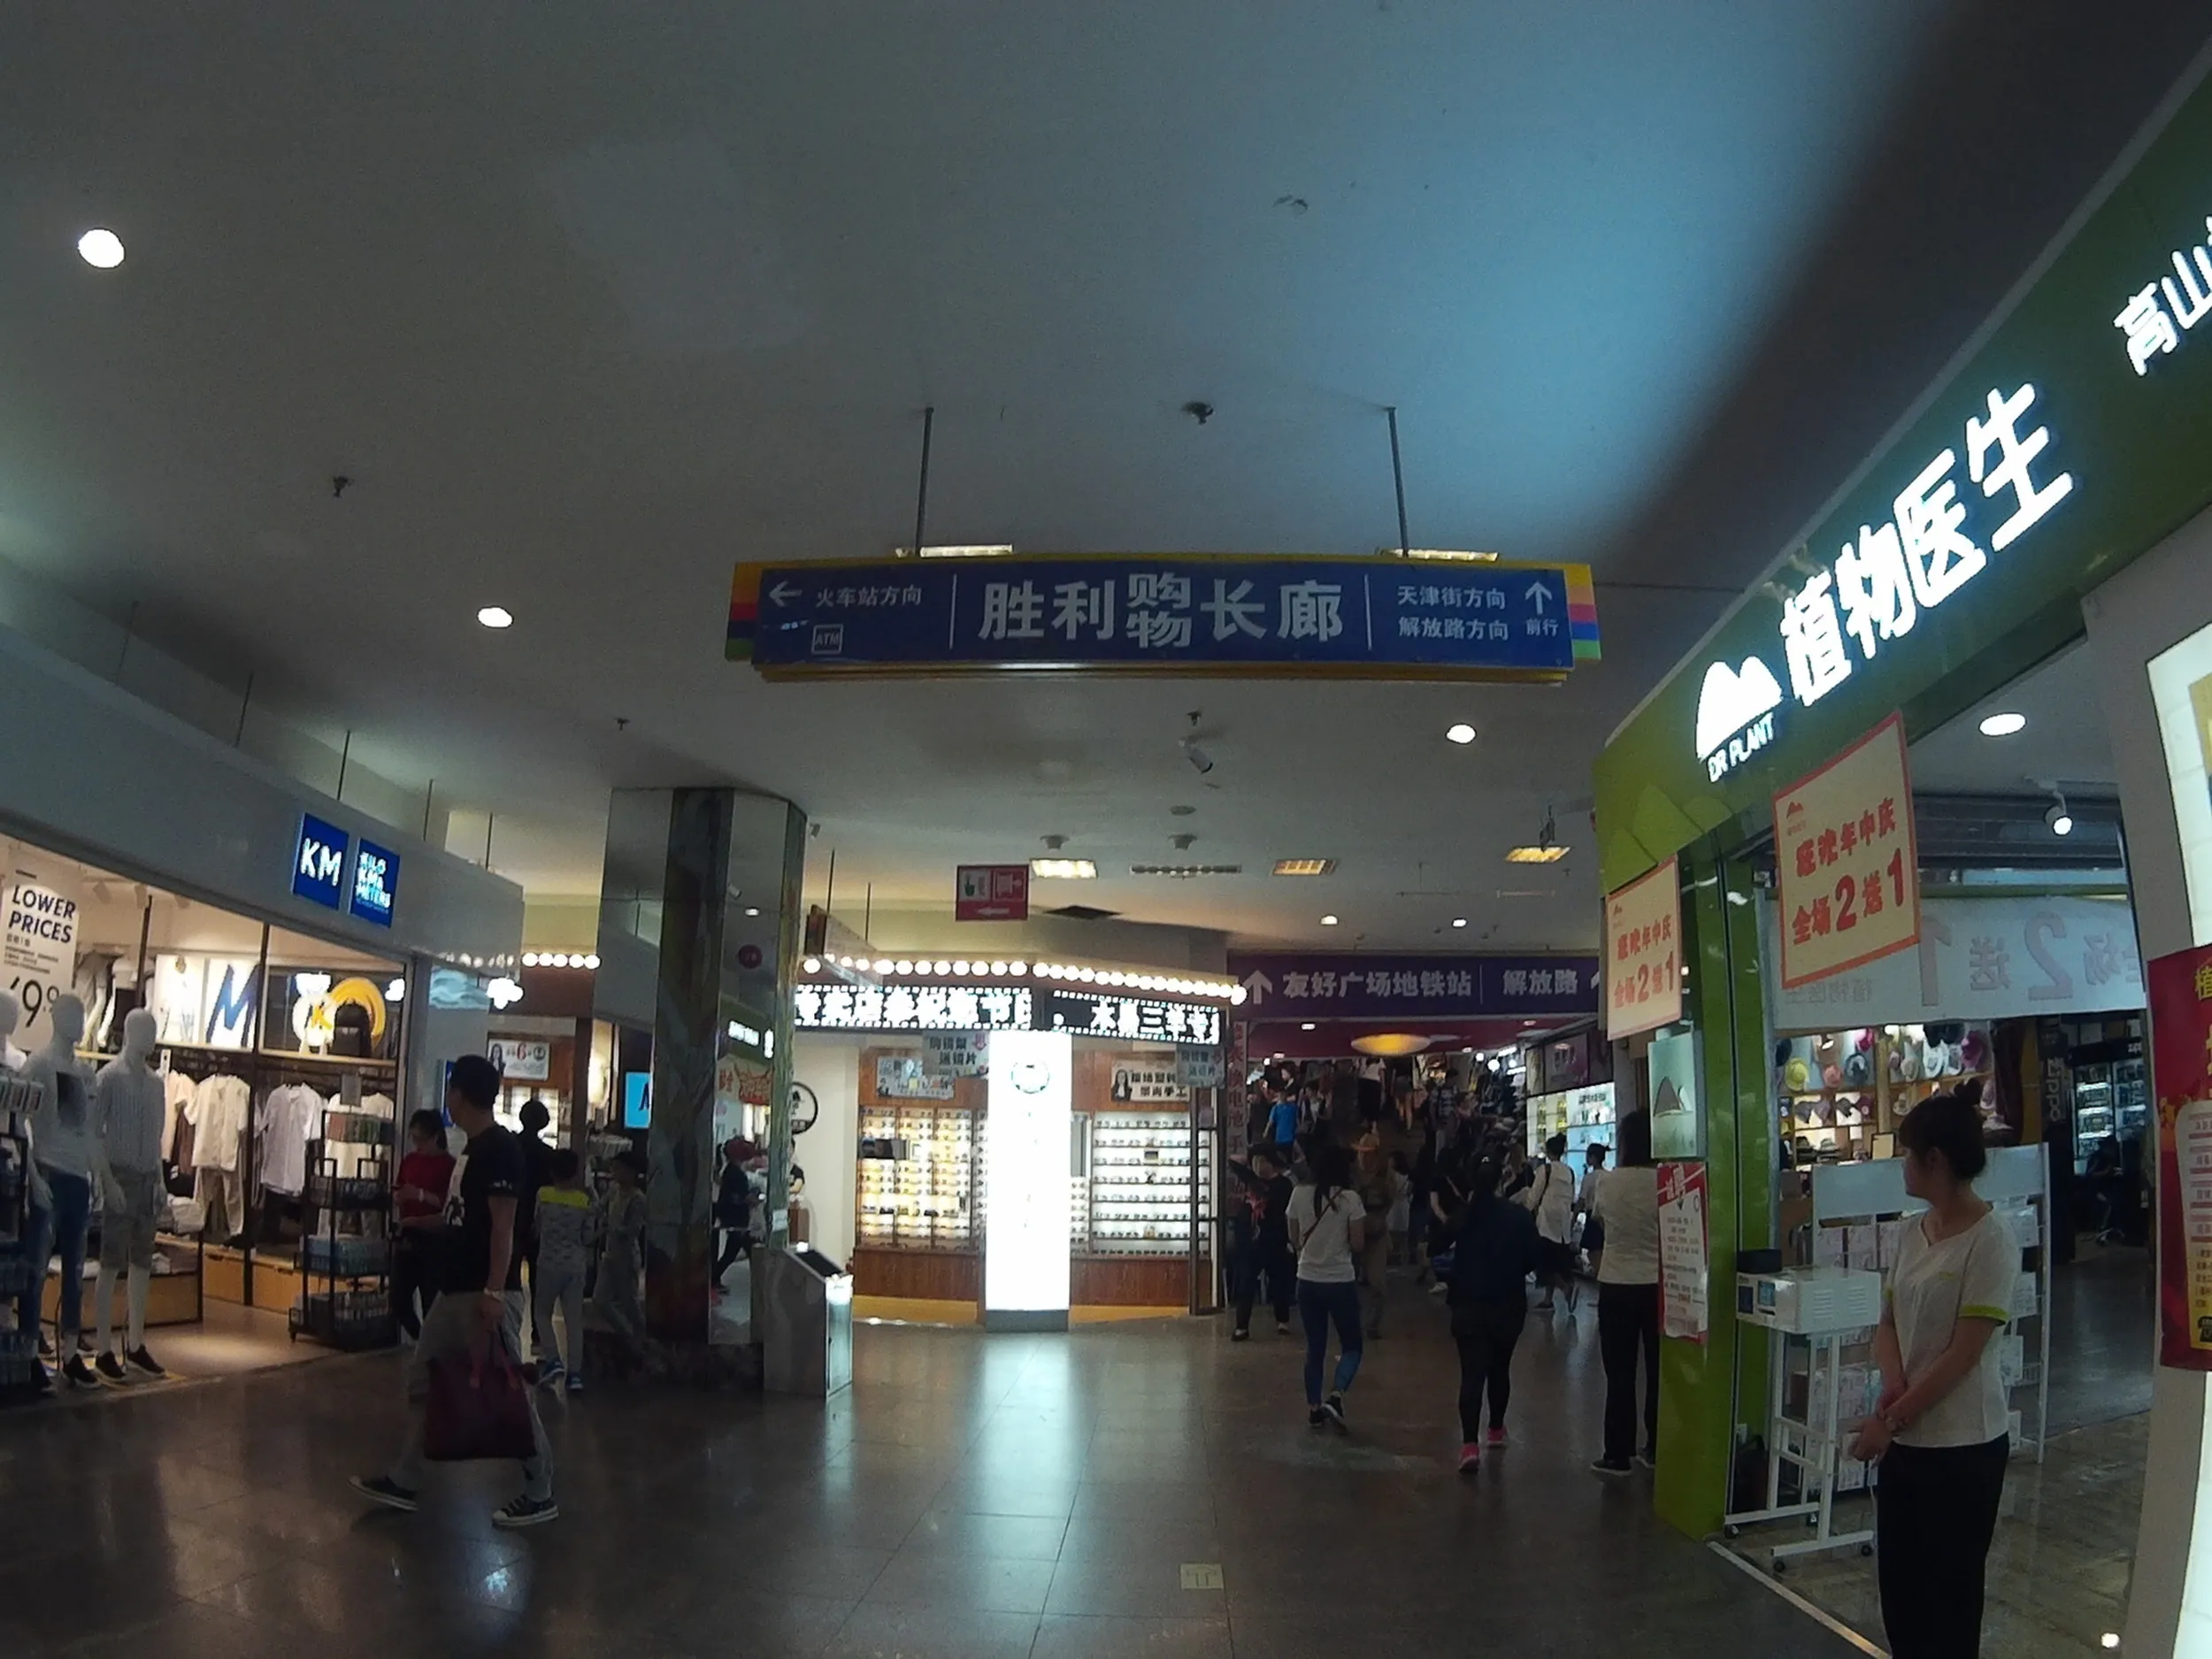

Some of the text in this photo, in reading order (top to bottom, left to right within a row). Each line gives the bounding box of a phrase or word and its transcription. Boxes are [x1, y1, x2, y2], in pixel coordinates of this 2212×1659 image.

[2113, 215, 2212, 376] 高山
[1780, 382, 2074, 706] 植物医生
[816, 584, 922, 608] 火车站方向
[1397, 585, 1506, 610] 天津街方向
[1398, 617, 1509, 641] 解放路方向
[1525, 618, 1559, 637] 前行
[1708, 711, 1776, 782] DR PLANT
[300, 837, 342, 887] KM
[12, 884, 77, 920] LOWER
[1792, 847, 1905, 946] 全场2送1
[8, 910, 73, 944] PRICES
[1282, 969, 1579, 999] 友好广场地铁站 解放路
